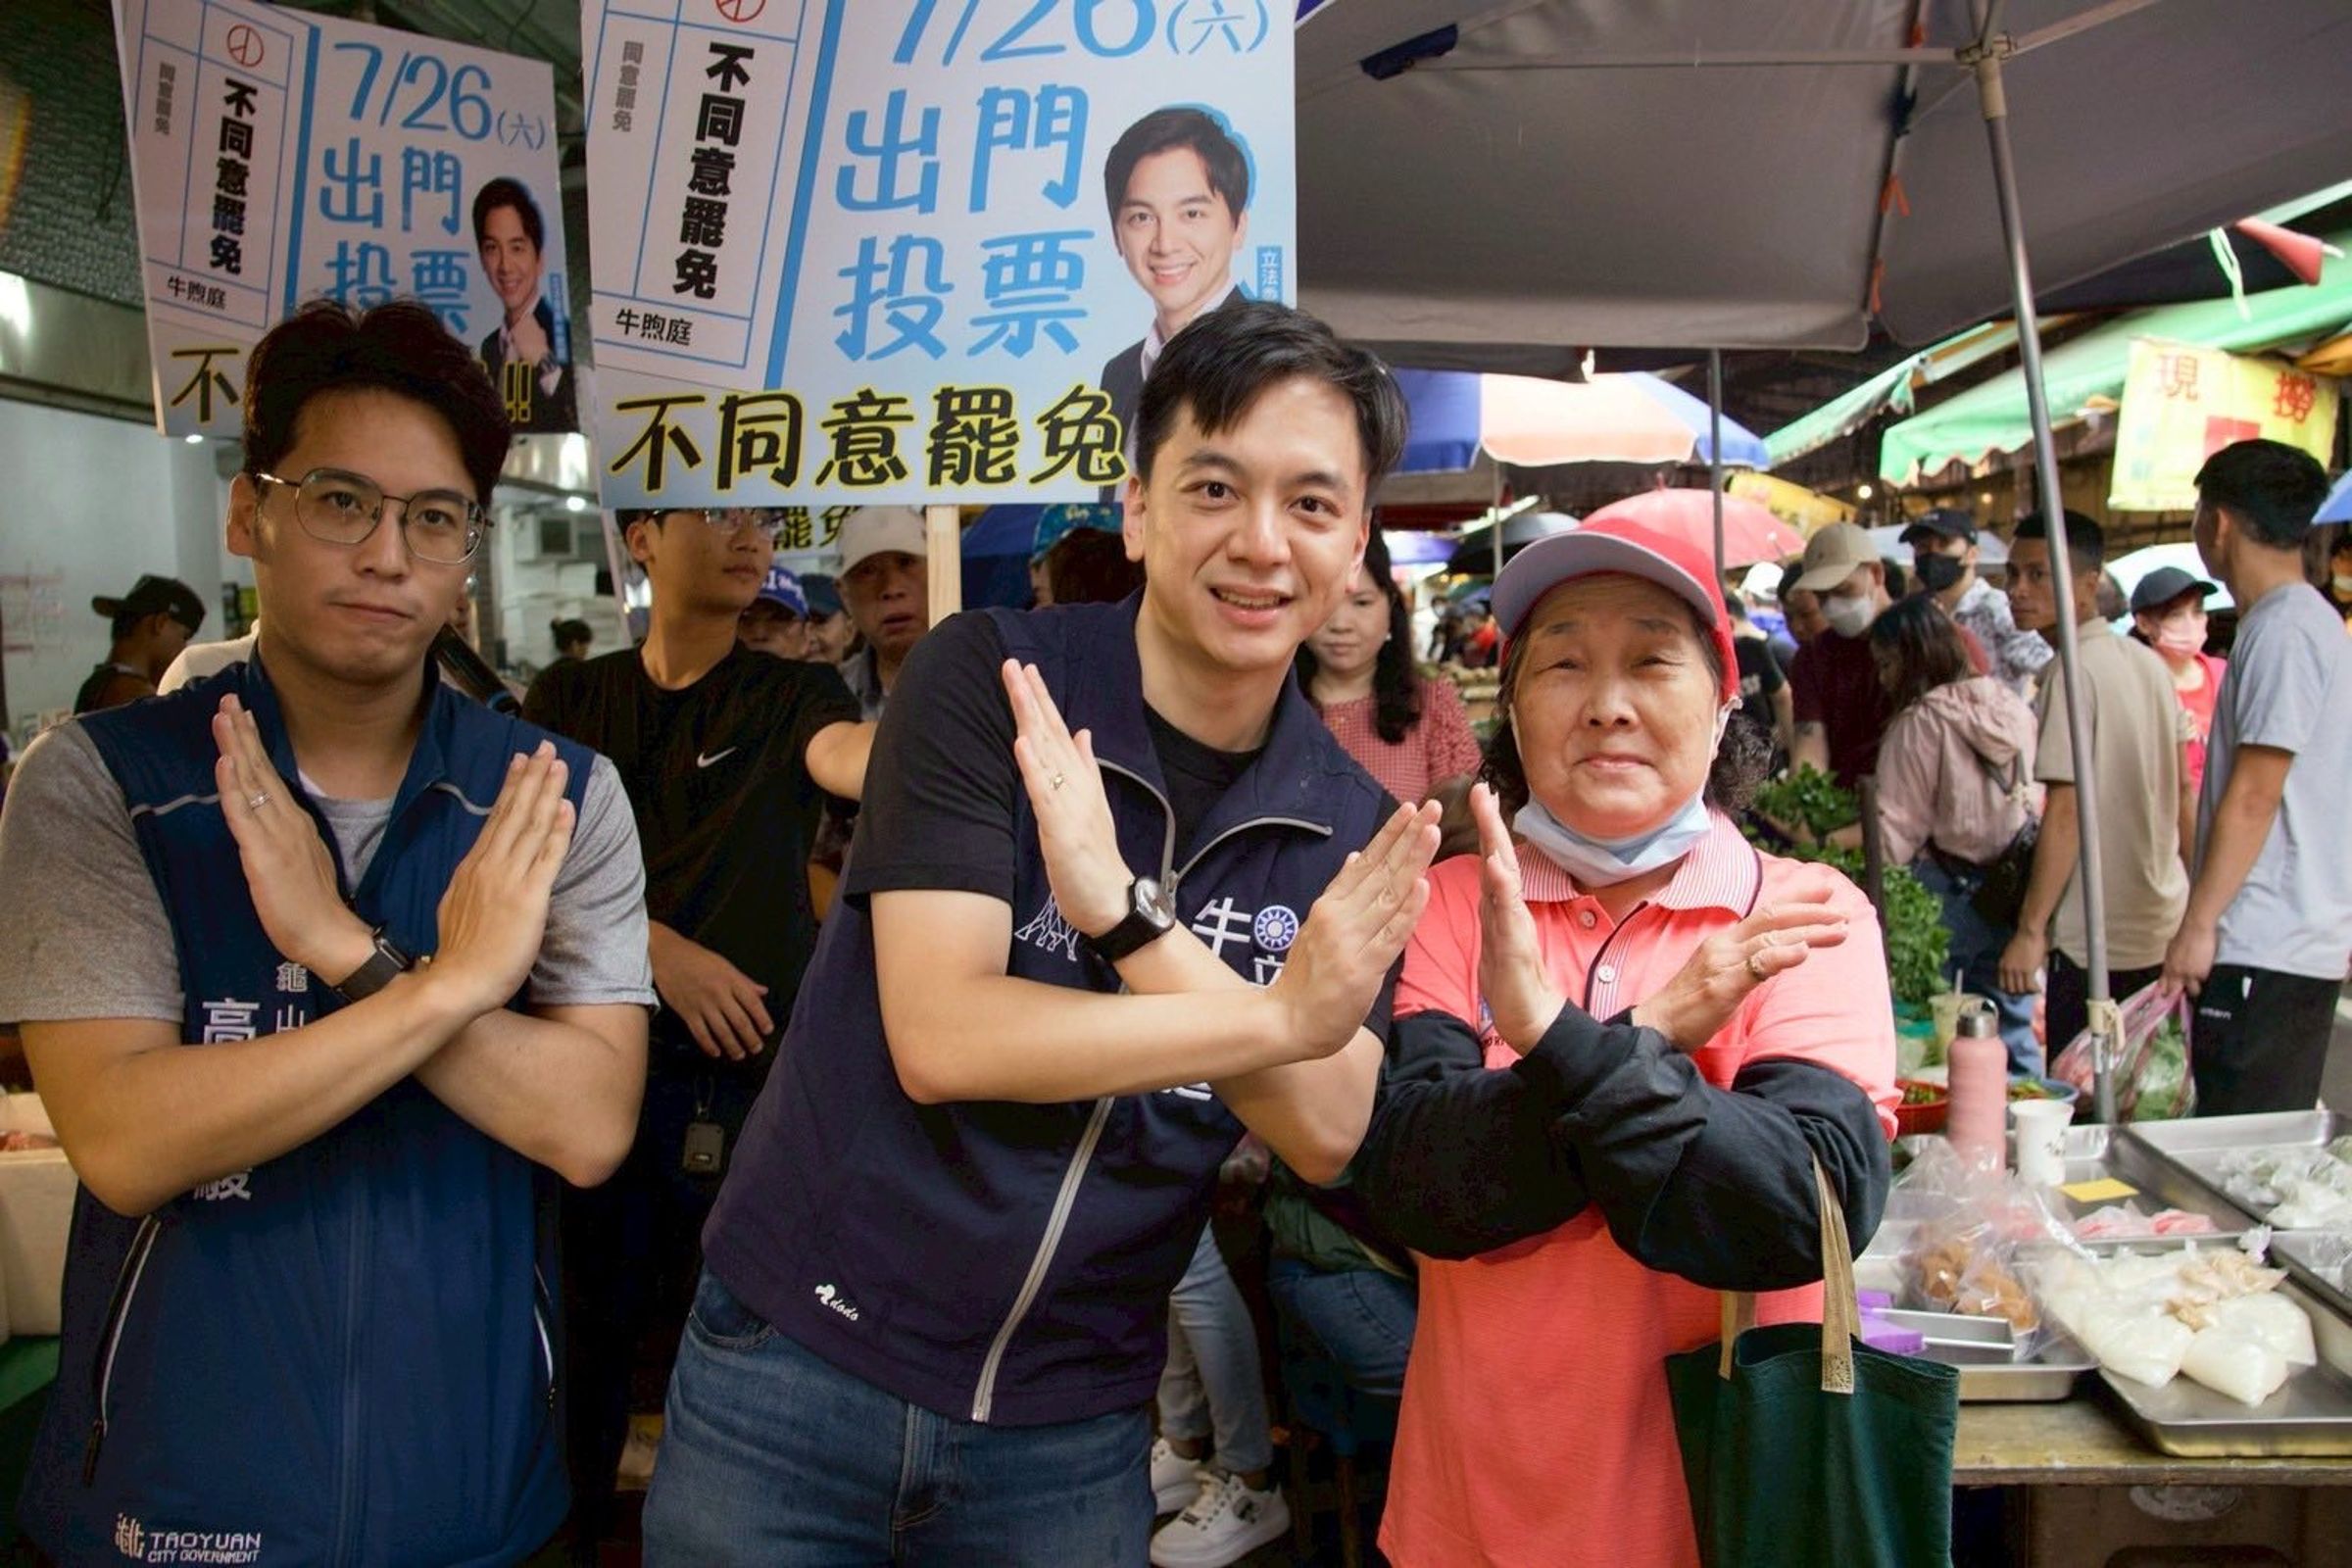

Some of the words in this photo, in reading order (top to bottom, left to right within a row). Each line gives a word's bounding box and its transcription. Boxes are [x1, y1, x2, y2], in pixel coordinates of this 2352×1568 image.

[334, 42, 546, 151] 7/26(六)
[210, 77, 258, 275] 不同意罷免
[319, 137, 464, 236] 出門
[673, 42, 755, 299] 不同意罷免
[836, 84, 1090, 215] 出門
[168, 275, 227, 310] 牛煦庭
[615, 308, 693, 346] 牛煦庭
[834, 229, 1095, 361] 投票
[612, 384, 1127, 491] 不同意罷免
[1192, 897, 1252, 956] 牛
[202, 998, 261, 1046] 高
[148, 1549, 177, 1563] CITY
[180, 1549, 260, 1564] GOVERNMENT
[149, 1532, 262, 1550] TAOYUAN
